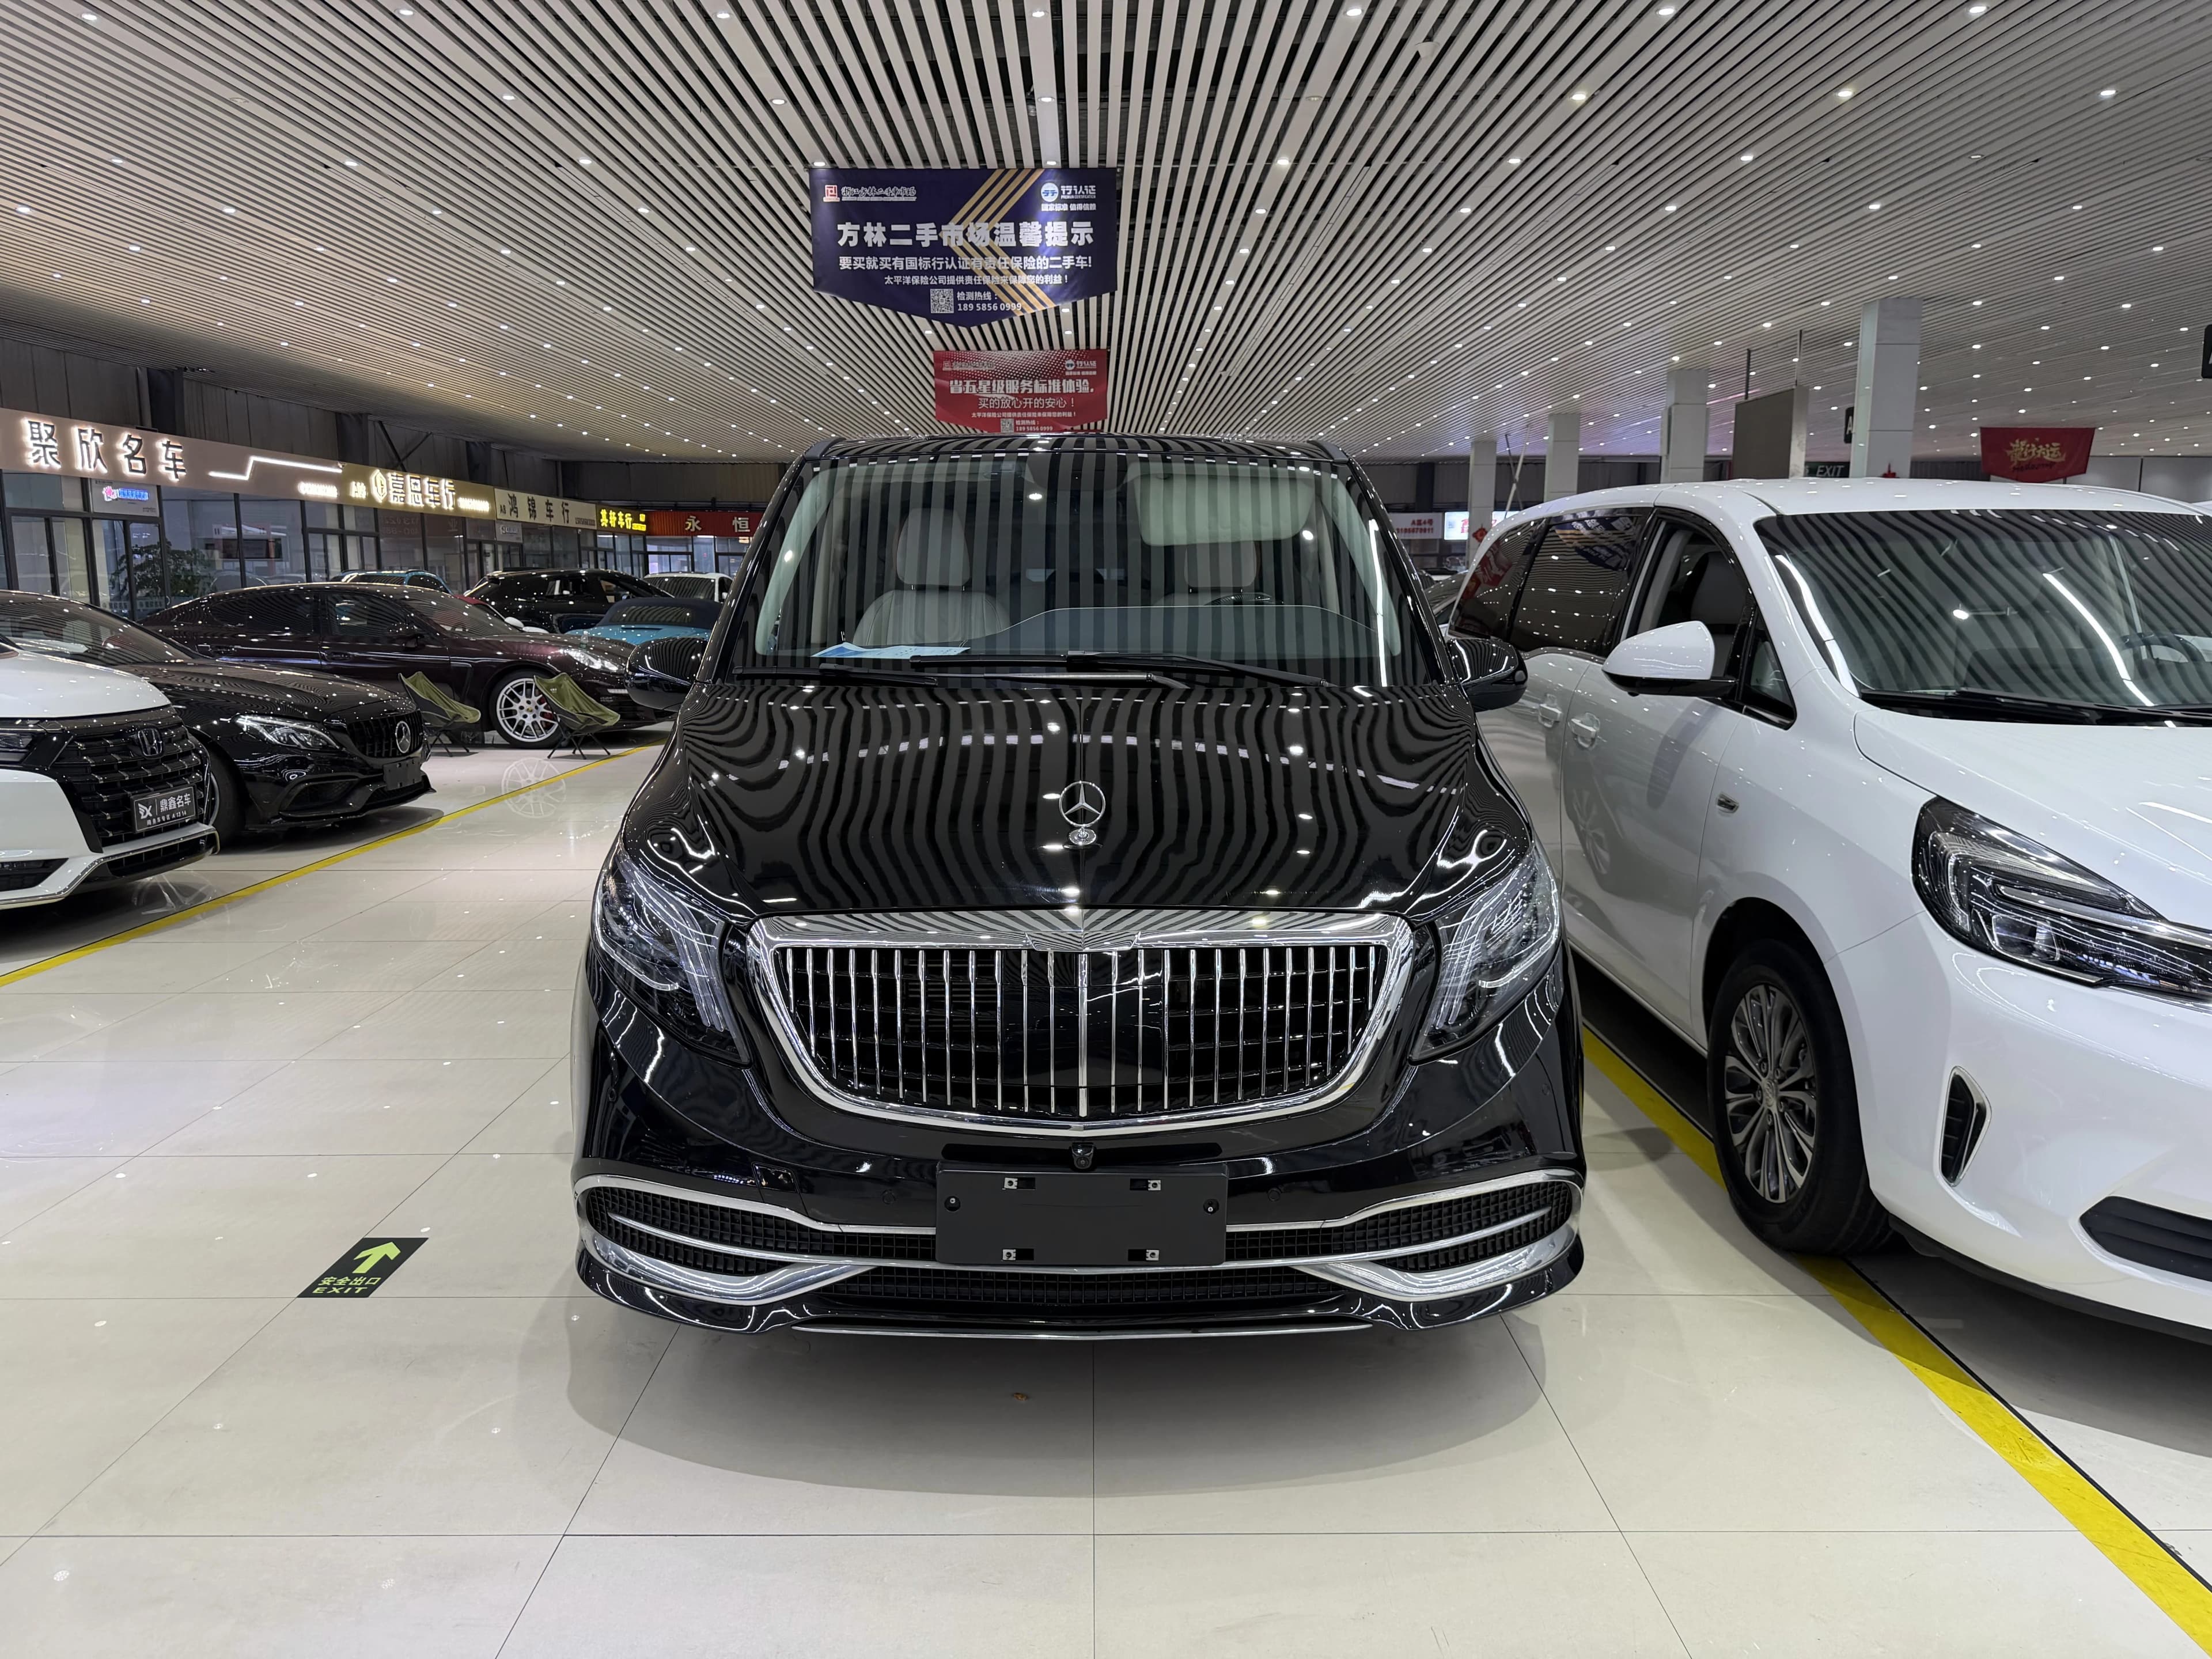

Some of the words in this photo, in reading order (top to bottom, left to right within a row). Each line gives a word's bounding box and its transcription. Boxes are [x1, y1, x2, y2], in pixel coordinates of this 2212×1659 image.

[837, 221, 1094, 248] 方林二手市场温馨提示
[957, 302, 974, 312] 189
[976, 302, 998, 312] 5856
[999, 302, 1022, 311] 0999
[25, 419, 187, 480] 聚欣名车
[1816, 465, 1844, 478] EXIT
[508, 493, 569, 524] 鸿锦车行
[160, 793, 191, 813] 鼎鑫名车
[318, 1276, 381, 1286] 安全出口
